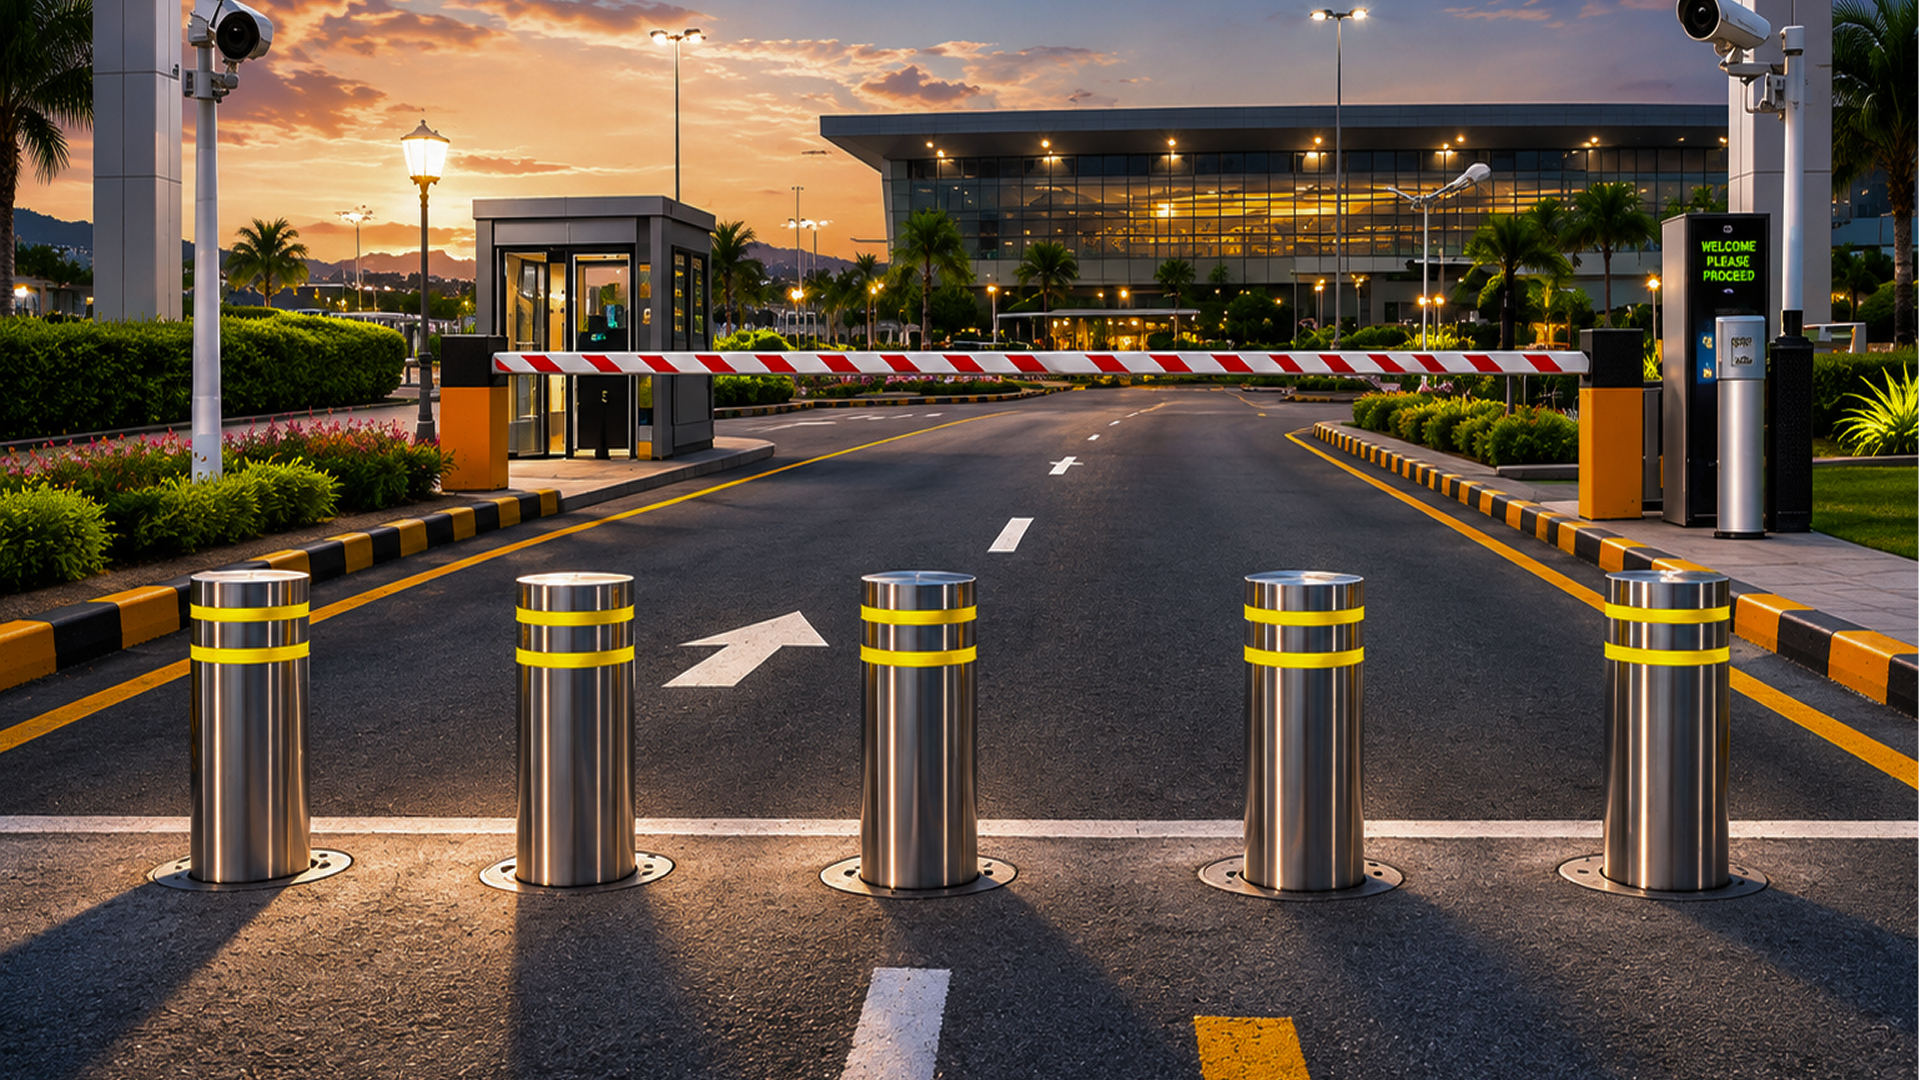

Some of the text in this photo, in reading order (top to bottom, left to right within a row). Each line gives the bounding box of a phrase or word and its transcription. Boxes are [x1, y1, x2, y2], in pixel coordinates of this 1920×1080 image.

[1701, 241, 1757, 252] WELCOME
[1706, 256, 1750, 268] PLEASE
[1703, 270, 1755, 282] PROCEED
